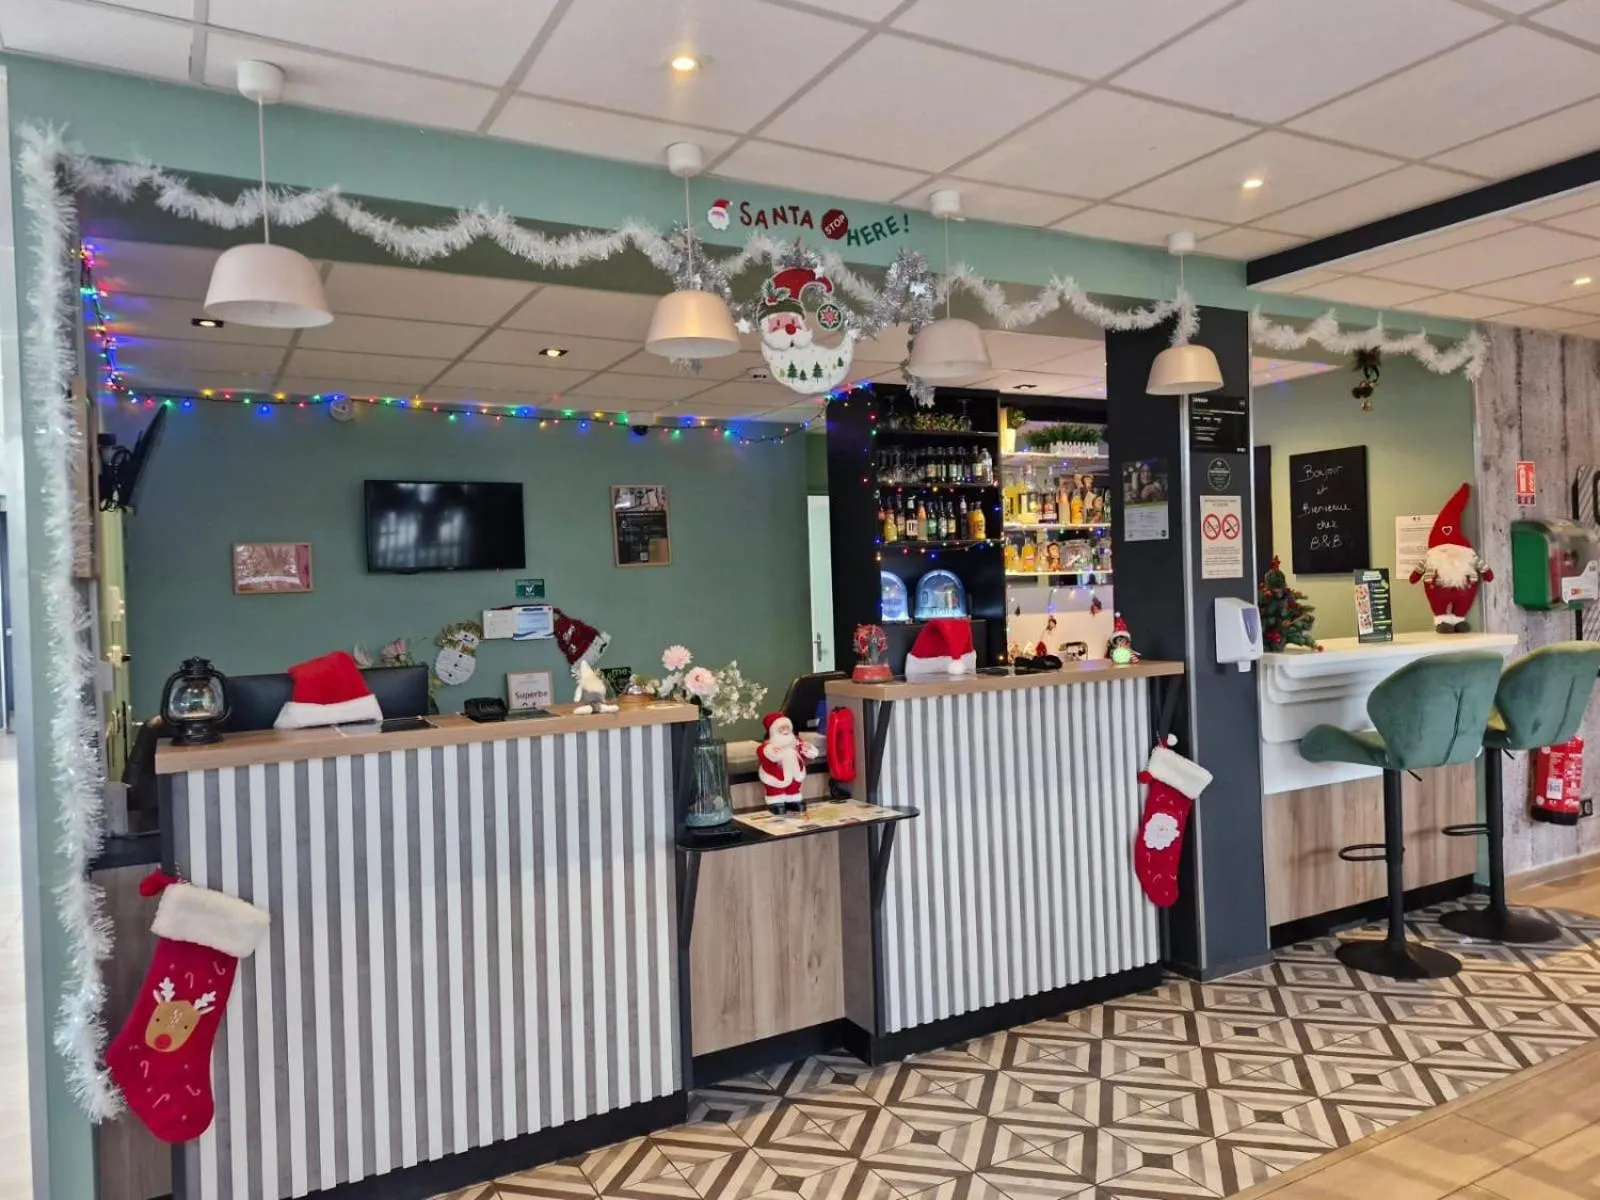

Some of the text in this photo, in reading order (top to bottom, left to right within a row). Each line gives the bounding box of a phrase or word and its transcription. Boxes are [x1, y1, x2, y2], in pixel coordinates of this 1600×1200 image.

[739, 201, 814, 230] SANTA
[824, 214, 847, 236] STOP
[1316, 520, 1339, 530] chez
[1310, 534, 1343, 551] B&B
[515, 690, 548, 700] Superbe
